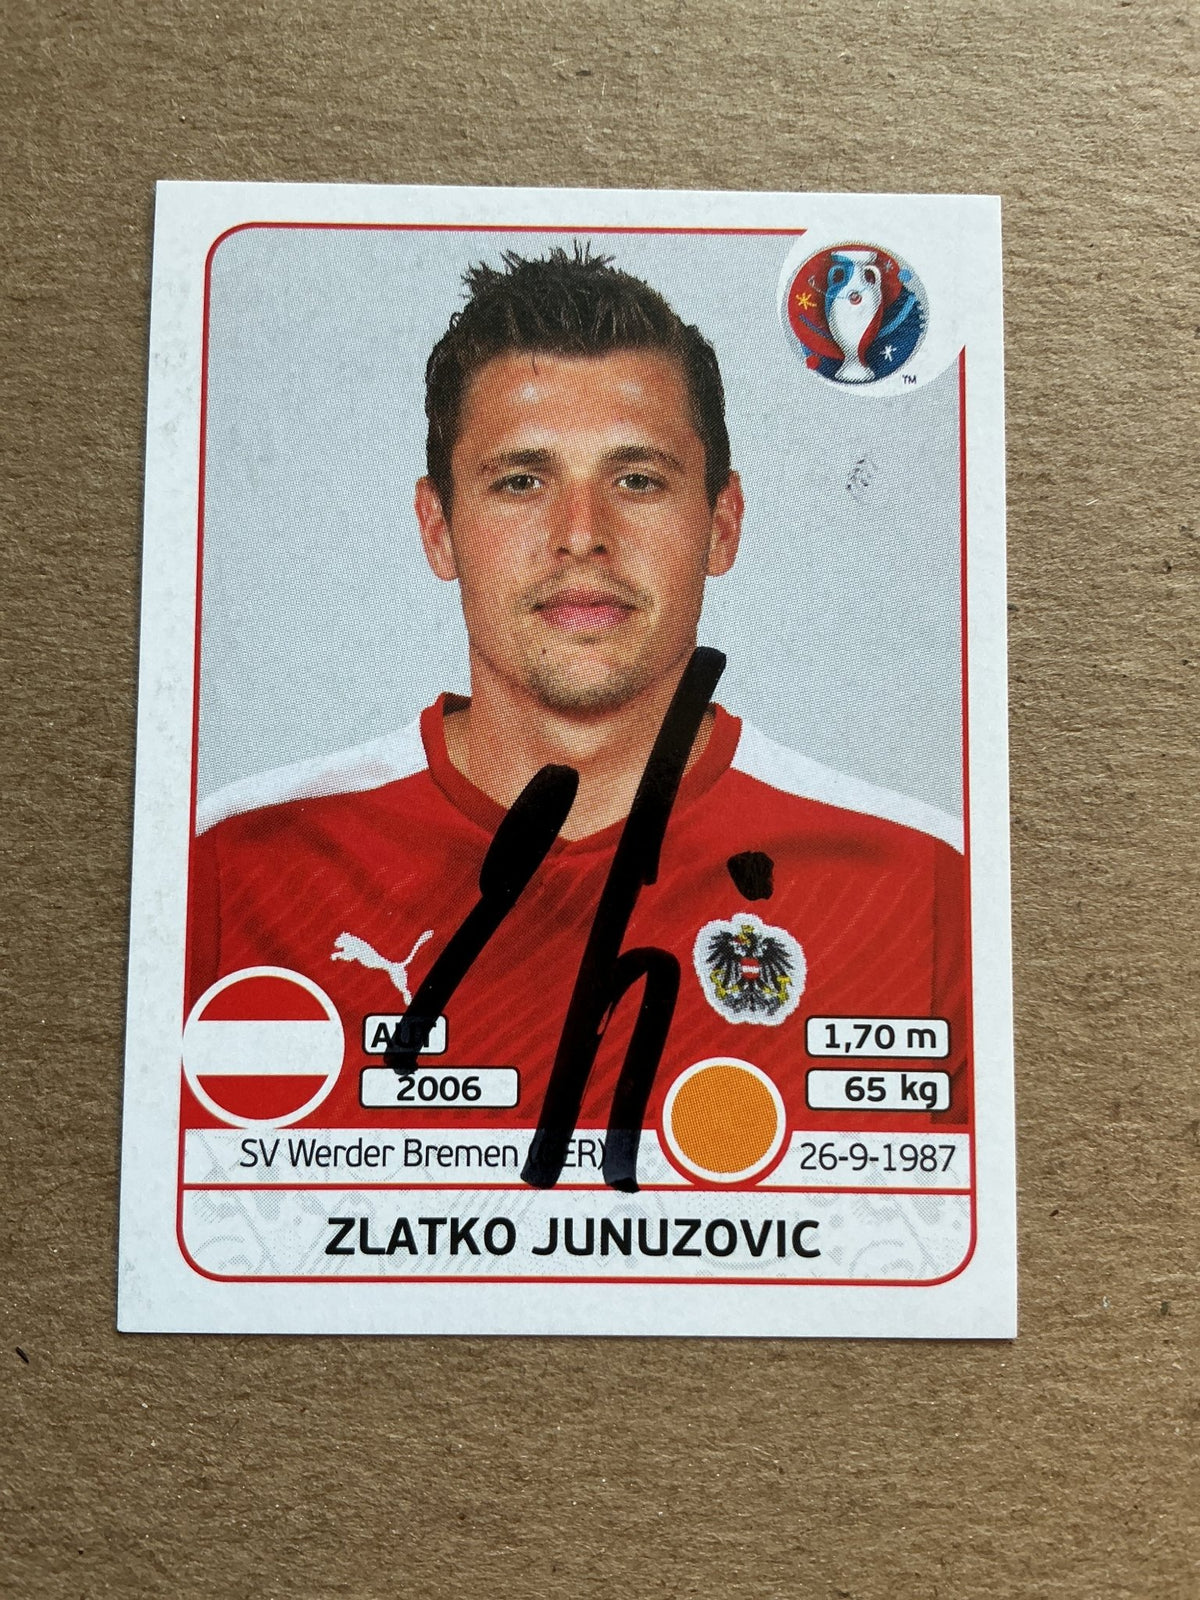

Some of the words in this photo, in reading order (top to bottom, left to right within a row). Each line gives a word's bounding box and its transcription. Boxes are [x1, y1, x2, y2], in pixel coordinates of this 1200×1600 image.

[825, 1024, 895, 1053] 1,70
[907, 1026, 937, 1049] m
[396, 1075, 482, 1102] 2006
[844, 1076, 887, 1102] 65
[901, 1074, 938, 1108] kg
[239, 1138, 280, 1168] SV
[288, 1137, 396, 1168] Werder
[403, 1138, 519, 1168] Bremen
[800, 1142, 957, 1172] 26-9-1987
[325, 1216, 517, 1256] ZLATKO
[531, 1217, 821, 1258] JUNUZOVIC
